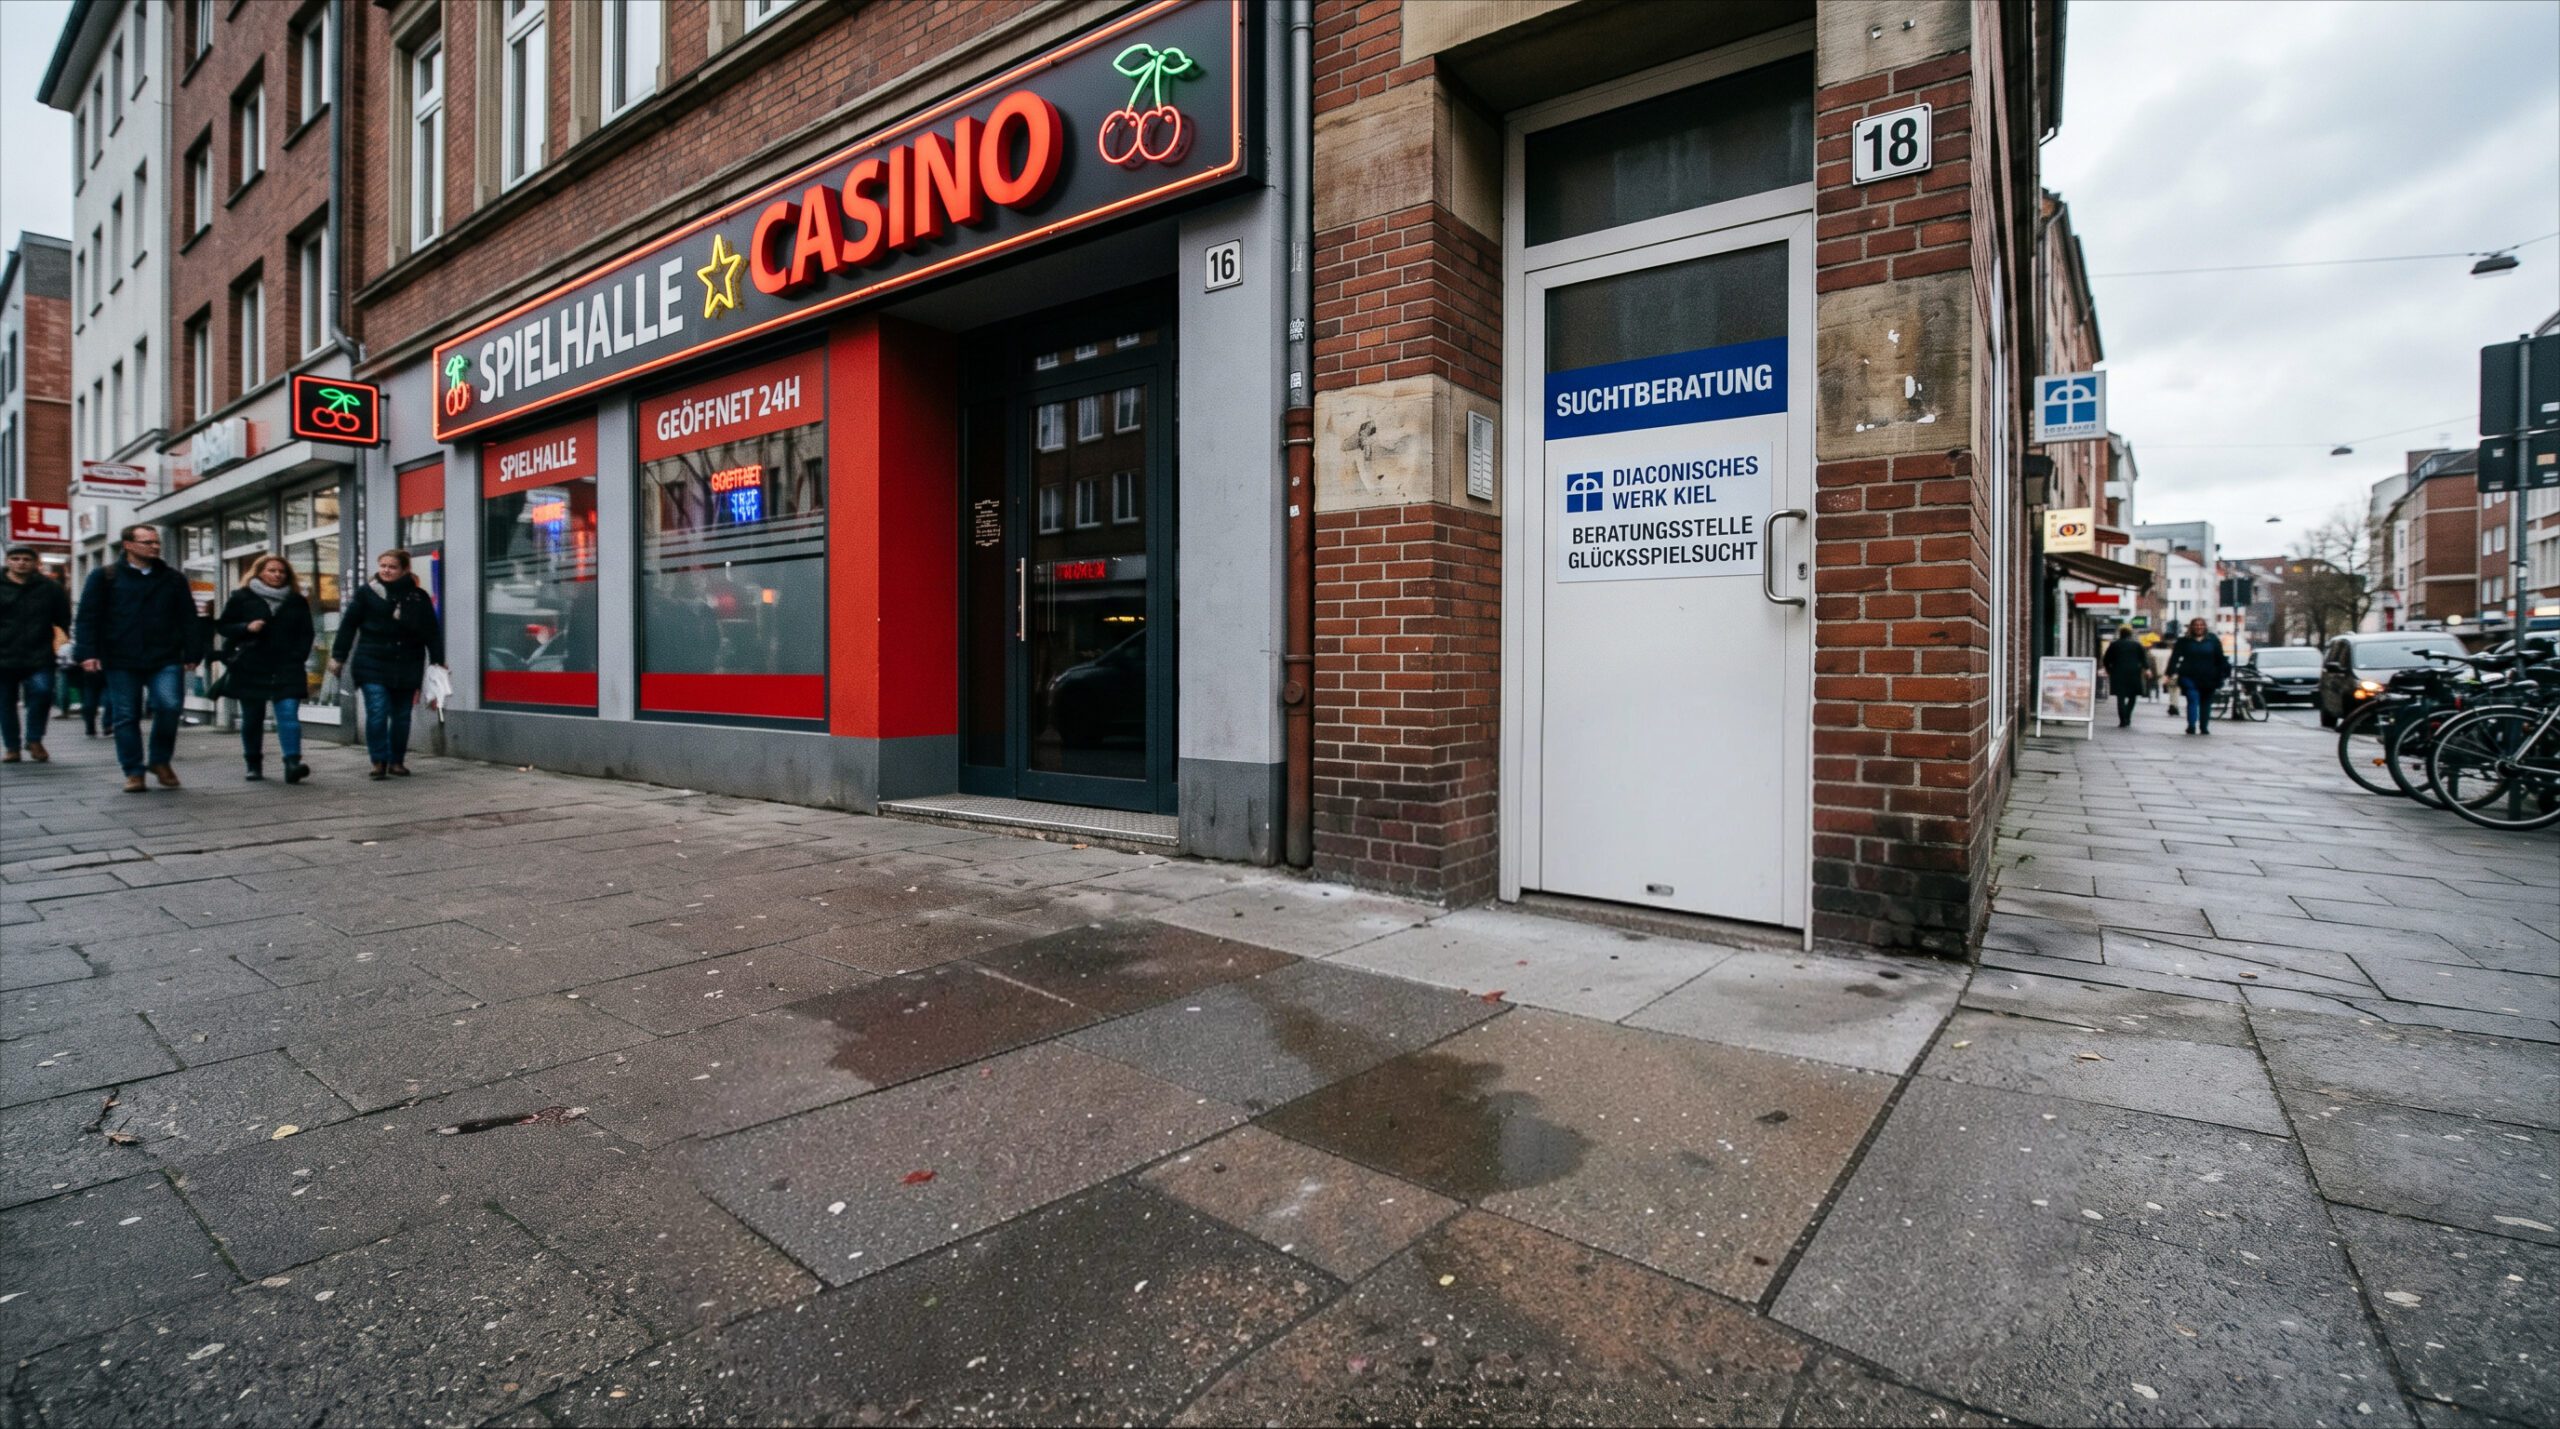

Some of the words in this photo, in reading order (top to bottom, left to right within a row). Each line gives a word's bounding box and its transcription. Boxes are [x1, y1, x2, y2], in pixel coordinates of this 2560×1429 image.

[1863, 117, 1918, 172] 18
[479, 256, 684, 404] SPIELHALLE
[750, 89, 1062, 296] CASINO
[1210, 248, 1235, 283] 16
[656, 387, 755, 441] GEÖFFNET
[758, 375, 801, 417] 24H
[1556, 363, 1773, 418] SUCHTBERATUNG
[500, 436, 577, 482] SPIELHALLE
[1612, 455, 1759, 488] DIACONISCHES
[1612, 488, 1668, 510] WERK
[1673, 484, 1717, 506] KIEL
[1572, 515, 1754, 545] BERATUNGSSTELLE
[1568, 541, 1758, 570] GLÜCKSSPIELSUCHT
